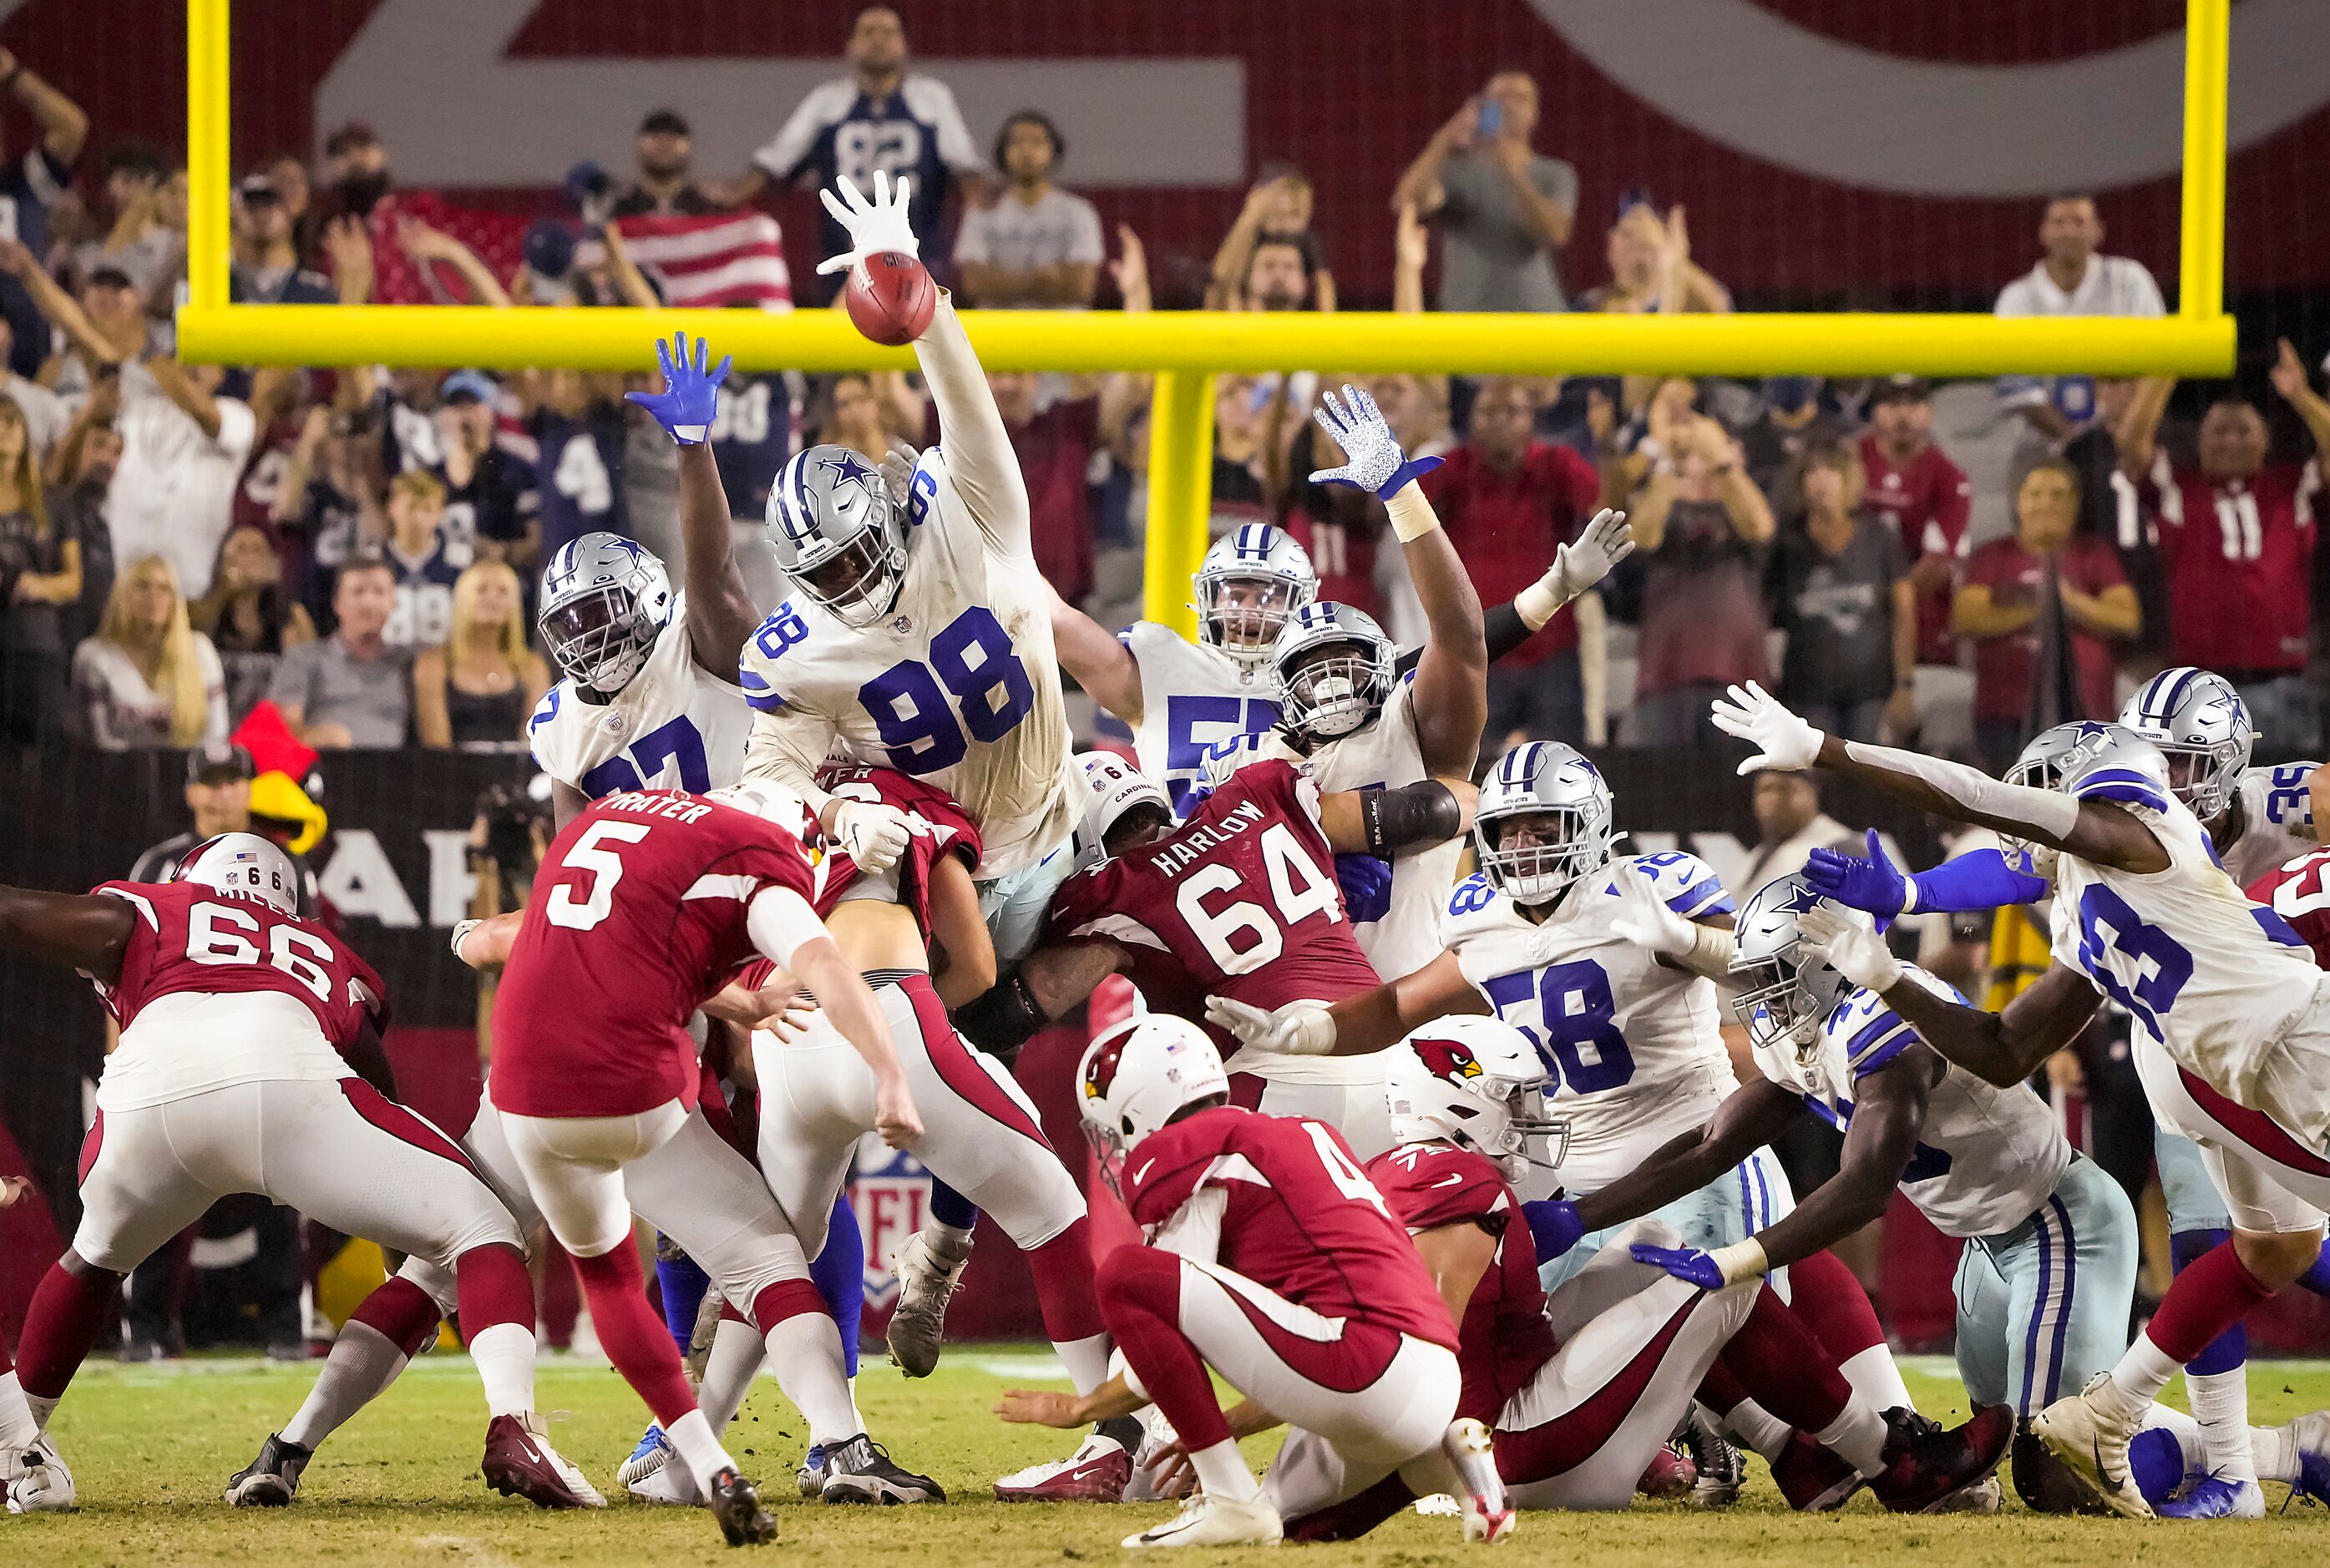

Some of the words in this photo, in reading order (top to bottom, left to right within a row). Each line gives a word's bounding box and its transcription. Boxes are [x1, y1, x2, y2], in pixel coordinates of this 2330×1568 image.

[554, 432, 615, 513] 4
[804, 544, 827, 559] COWBOYS
[2215, 491, 2262, 560] 11
[858, 605, 1035, 776] 98
[595, 792, 713, 825] PRATER
[1150, 799, 1266, 878] HARLOW
[545, 819, 652, 932] 5
[1175, 822, 1343, 976] 64
[186, 900, 334, 1003] 66
[1479, 958, 1637, 1097] 58
[1300, 1121, 1393, 1220] 4
